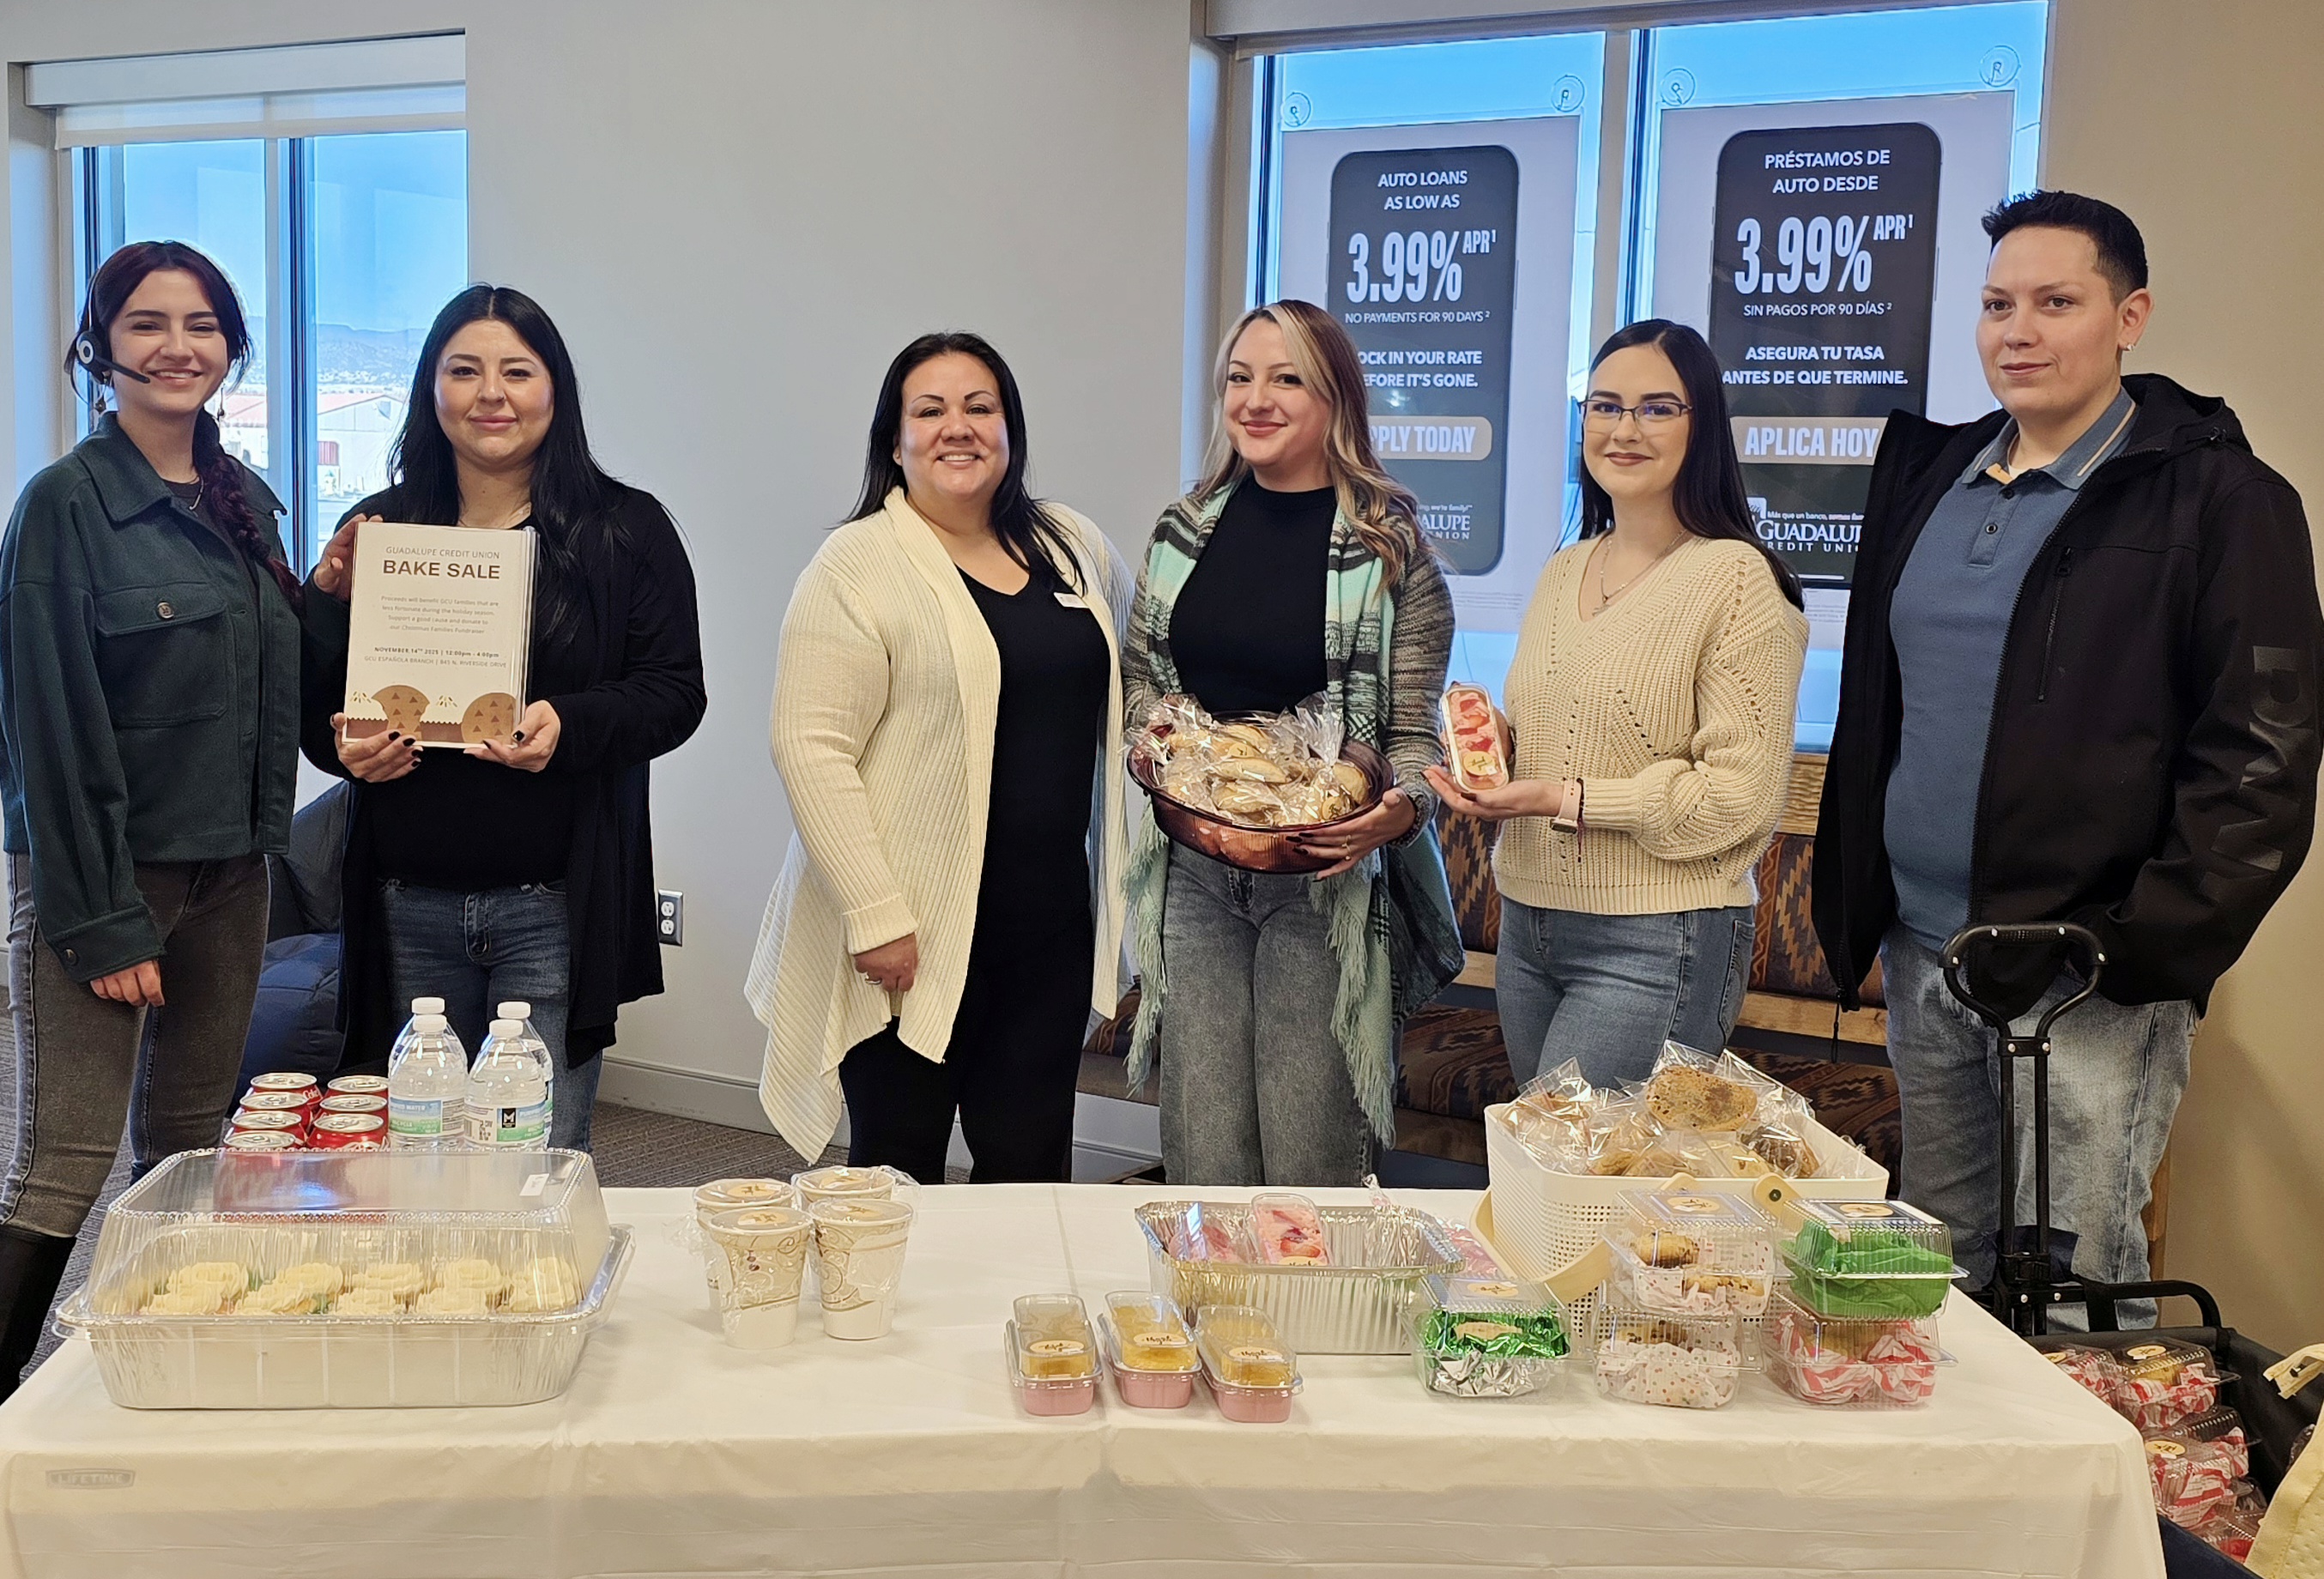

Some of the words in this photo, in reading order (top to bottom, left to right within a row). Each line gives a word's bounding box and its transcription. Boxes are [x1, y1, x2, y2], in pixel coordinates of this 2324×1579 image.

[1764, 150, 1863, 170] PRÉSTAMOS
[1867, 149, 1891, 166] DE
[1377, 172, 1418, 188] AUTO
[1419, 170, 1468, 187] LOANS
[1772, 178, 1819, 194] AUTO
[1822, 175, 1879, 192] DESDE
[1383, 197, 1403, 211] AS
[1405, 195, 1439, 209] LOW
[1440, 194, 1461, 209] AS
[1734, 215, 1873, 294] 3.99%
[1347, 230, 1463, 303] 3.99%
[1743, 305, 1764, 317] SIN
[1766, 304, 1808, 317] PAGOS
[1810, 304, 1837, 316] POR
[1838, 304, 1854, 316] 90
[1855, 300, 1885, 315] DÍAS
[1345, 312, 1362, 324] NO
[1364, 312, 1418, 324] PAYMENTS
[1419, 312, 1441, 323] FOR
[1442, 312, 1455, 323] 90
[1456, 311, 1484, 323] DAYS
[1358, 351, 1388, 365] OCK
[1389, 351, 1404, 365] IN
[1406, 351, 1445, 365] YOUR
[1448, 350, 1483, 365] RATE
[1746, 346, 1819, 360] ASEGURA
[1821, 347, 1843, 360] TU
[1844, 346, 1885, 360] TASA
[1363, 373, 1405, 387] EFORE
[1407, 373, 1431, 387] IT'S
[1433, 373, 1479, 387] GONE.
[1722, 371, 1770, 384] ANTES
[1773, 371, 1794, 384] DE
[1797, 371, 1831, 385] QUE
[1834, 371, 1909, 384] TERMINE.
[1413, 426, 1477, 453] TODAY
[1745, 427, 1825, 457] APLICA
[1831, 427, 1879, 458] HOY
[386, 546, 437, 556] GUADALUPE
[439, 549, 470, 558] CREDIT
[1767, 541, 1814, 552] REDIT
[383, 560, 440, 576] BAKE
[447, 563, 500, 579] SALE
